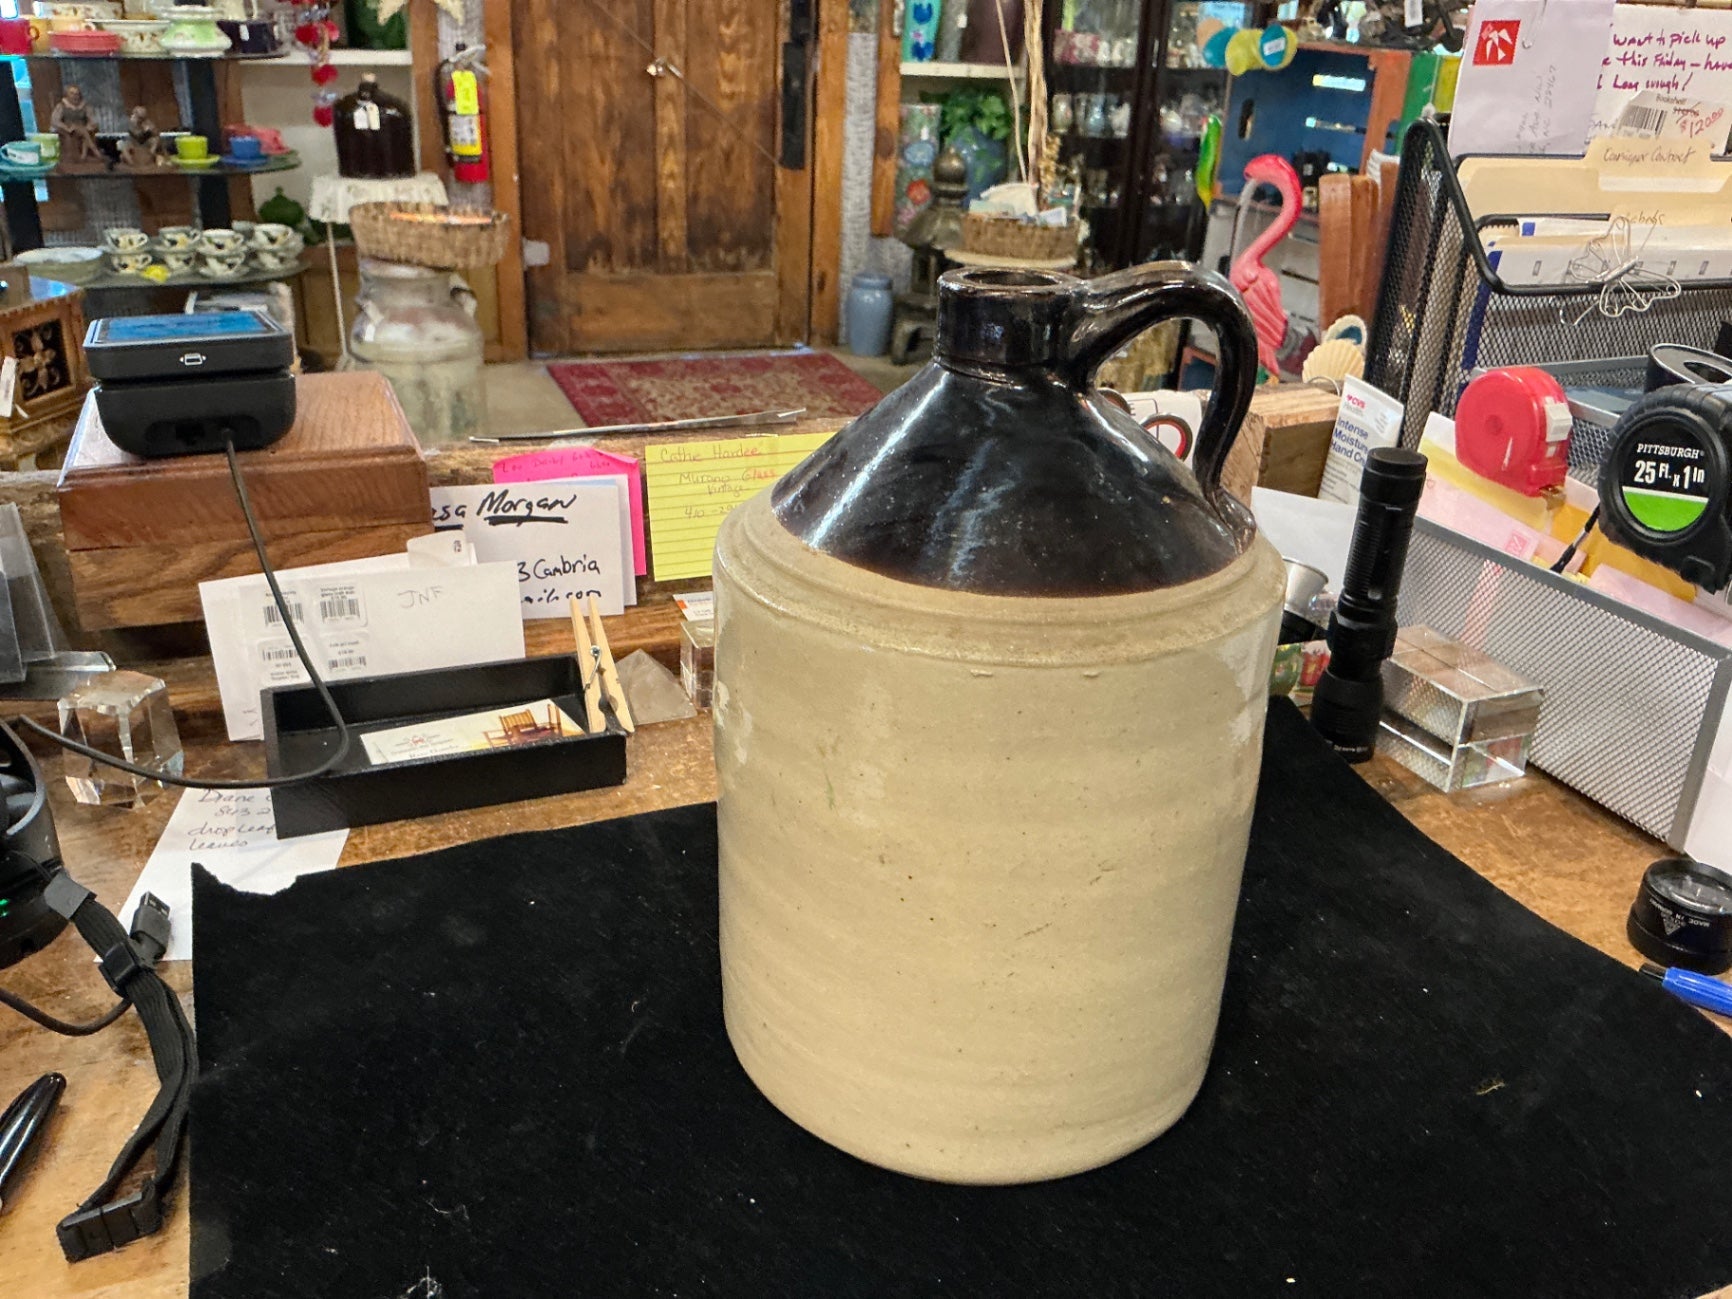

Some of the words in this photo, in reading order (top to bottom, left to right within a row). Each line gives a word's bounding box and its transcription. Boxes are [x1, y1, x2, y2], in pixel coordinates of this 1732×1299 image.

[1613, 32, 1653, 46] want
[1669, 30, 1701, 48] pick
[1705, 34, 1726, 50] up
[1616, 51, 1648, 67] this
[1351, 397, 1367, 409] CVS
[1338, 417, 1369, 440] Intense
[1331, 440, 1354, 459] Hand
[1333, 428, 1369, 455] Moistur
[1636, 442, 1700, 460] PITTSBURGH
[1633, 459, 1657, 485] 25
[1672, 473, 1681, 488] x
[1683, 465, 1691, 490] 1
[476, 488, 577, 520] Morgan
[533, 554, 600, 580] Cambria
